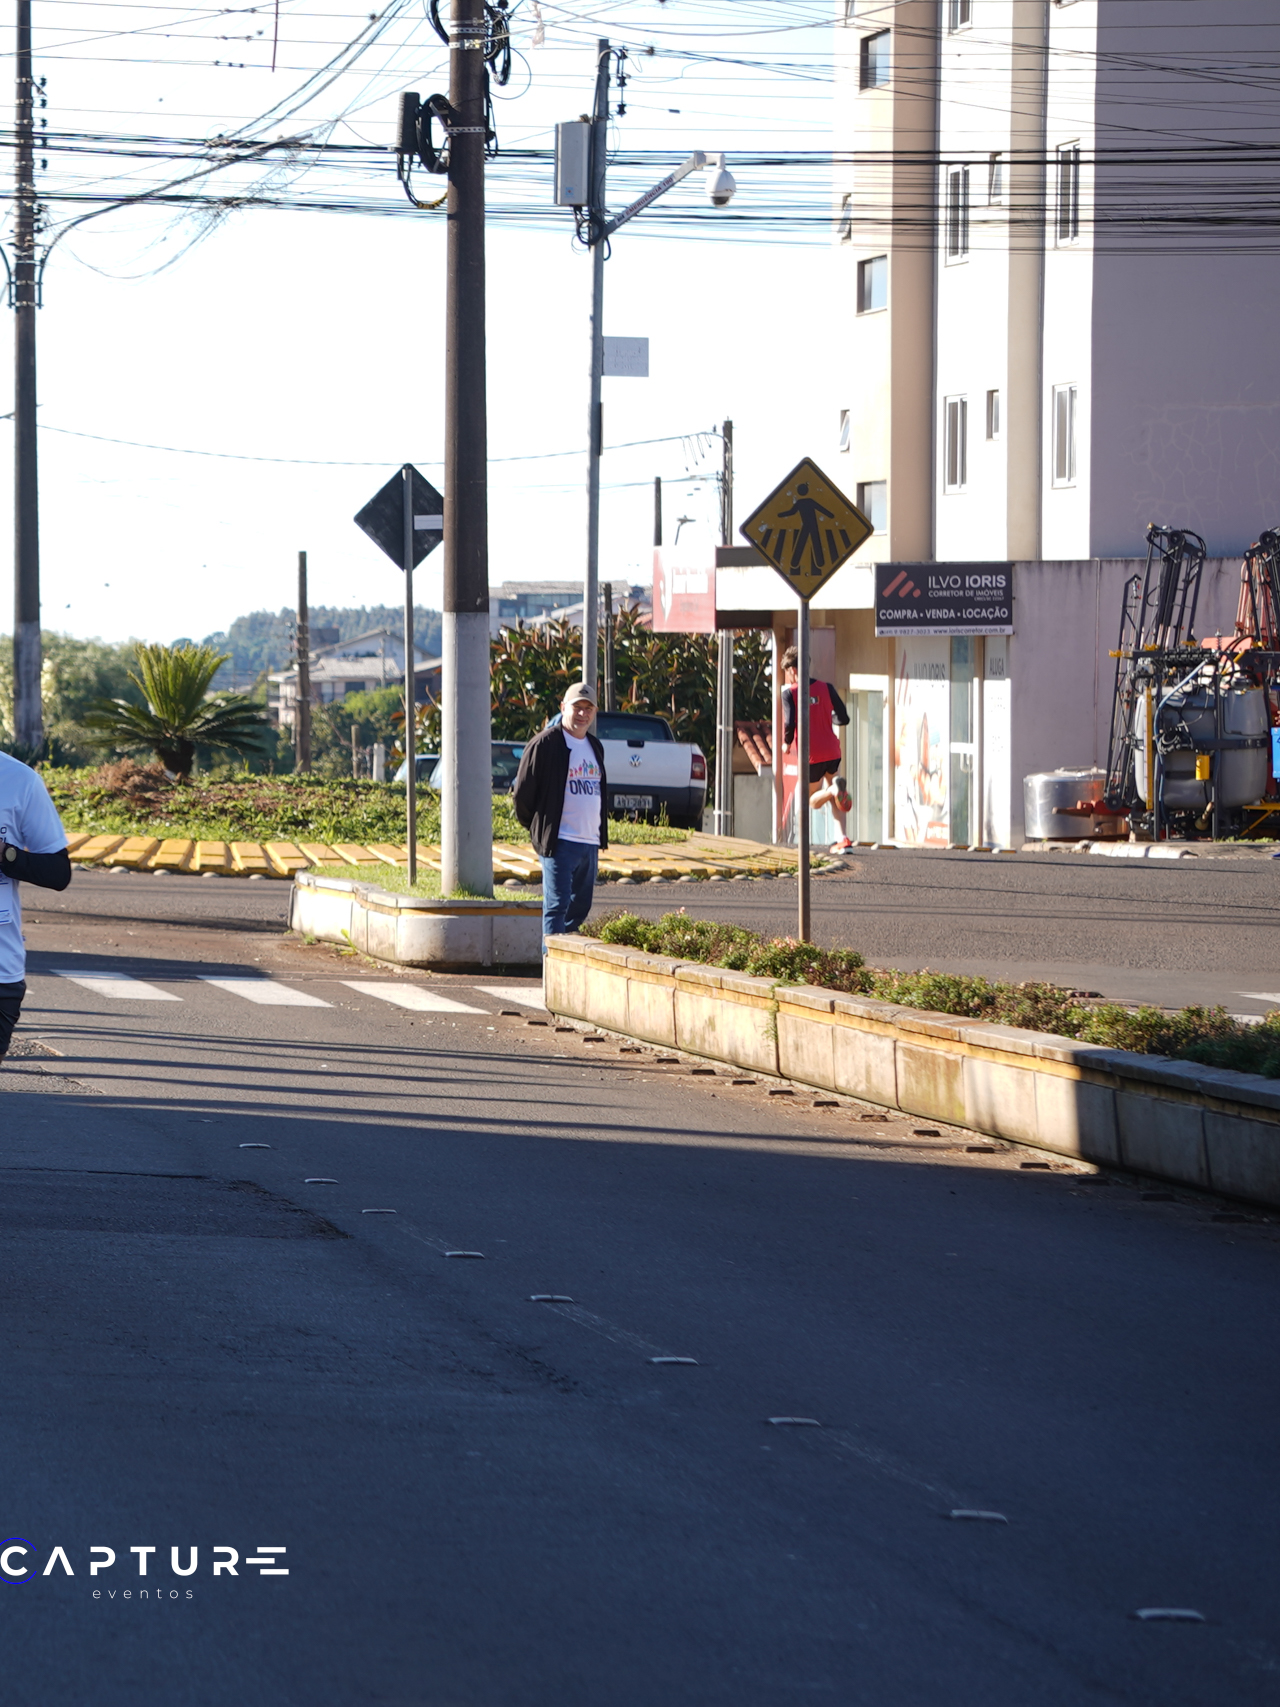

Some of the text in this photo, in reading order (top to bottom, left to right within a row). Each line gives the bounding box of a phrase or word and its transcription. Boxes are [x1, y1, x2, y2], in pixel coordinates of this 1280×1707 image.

[928, 574, 1006, 589] ILVO IORIS
[928, 590, 964, 598] CORRETOR
[976, 588, 1004, 597] IMÓVEIS
[879, 606, 1009, 620] COMPRA VENDA LOCAÇÃO
[569, 779, 594, 795] ONG
